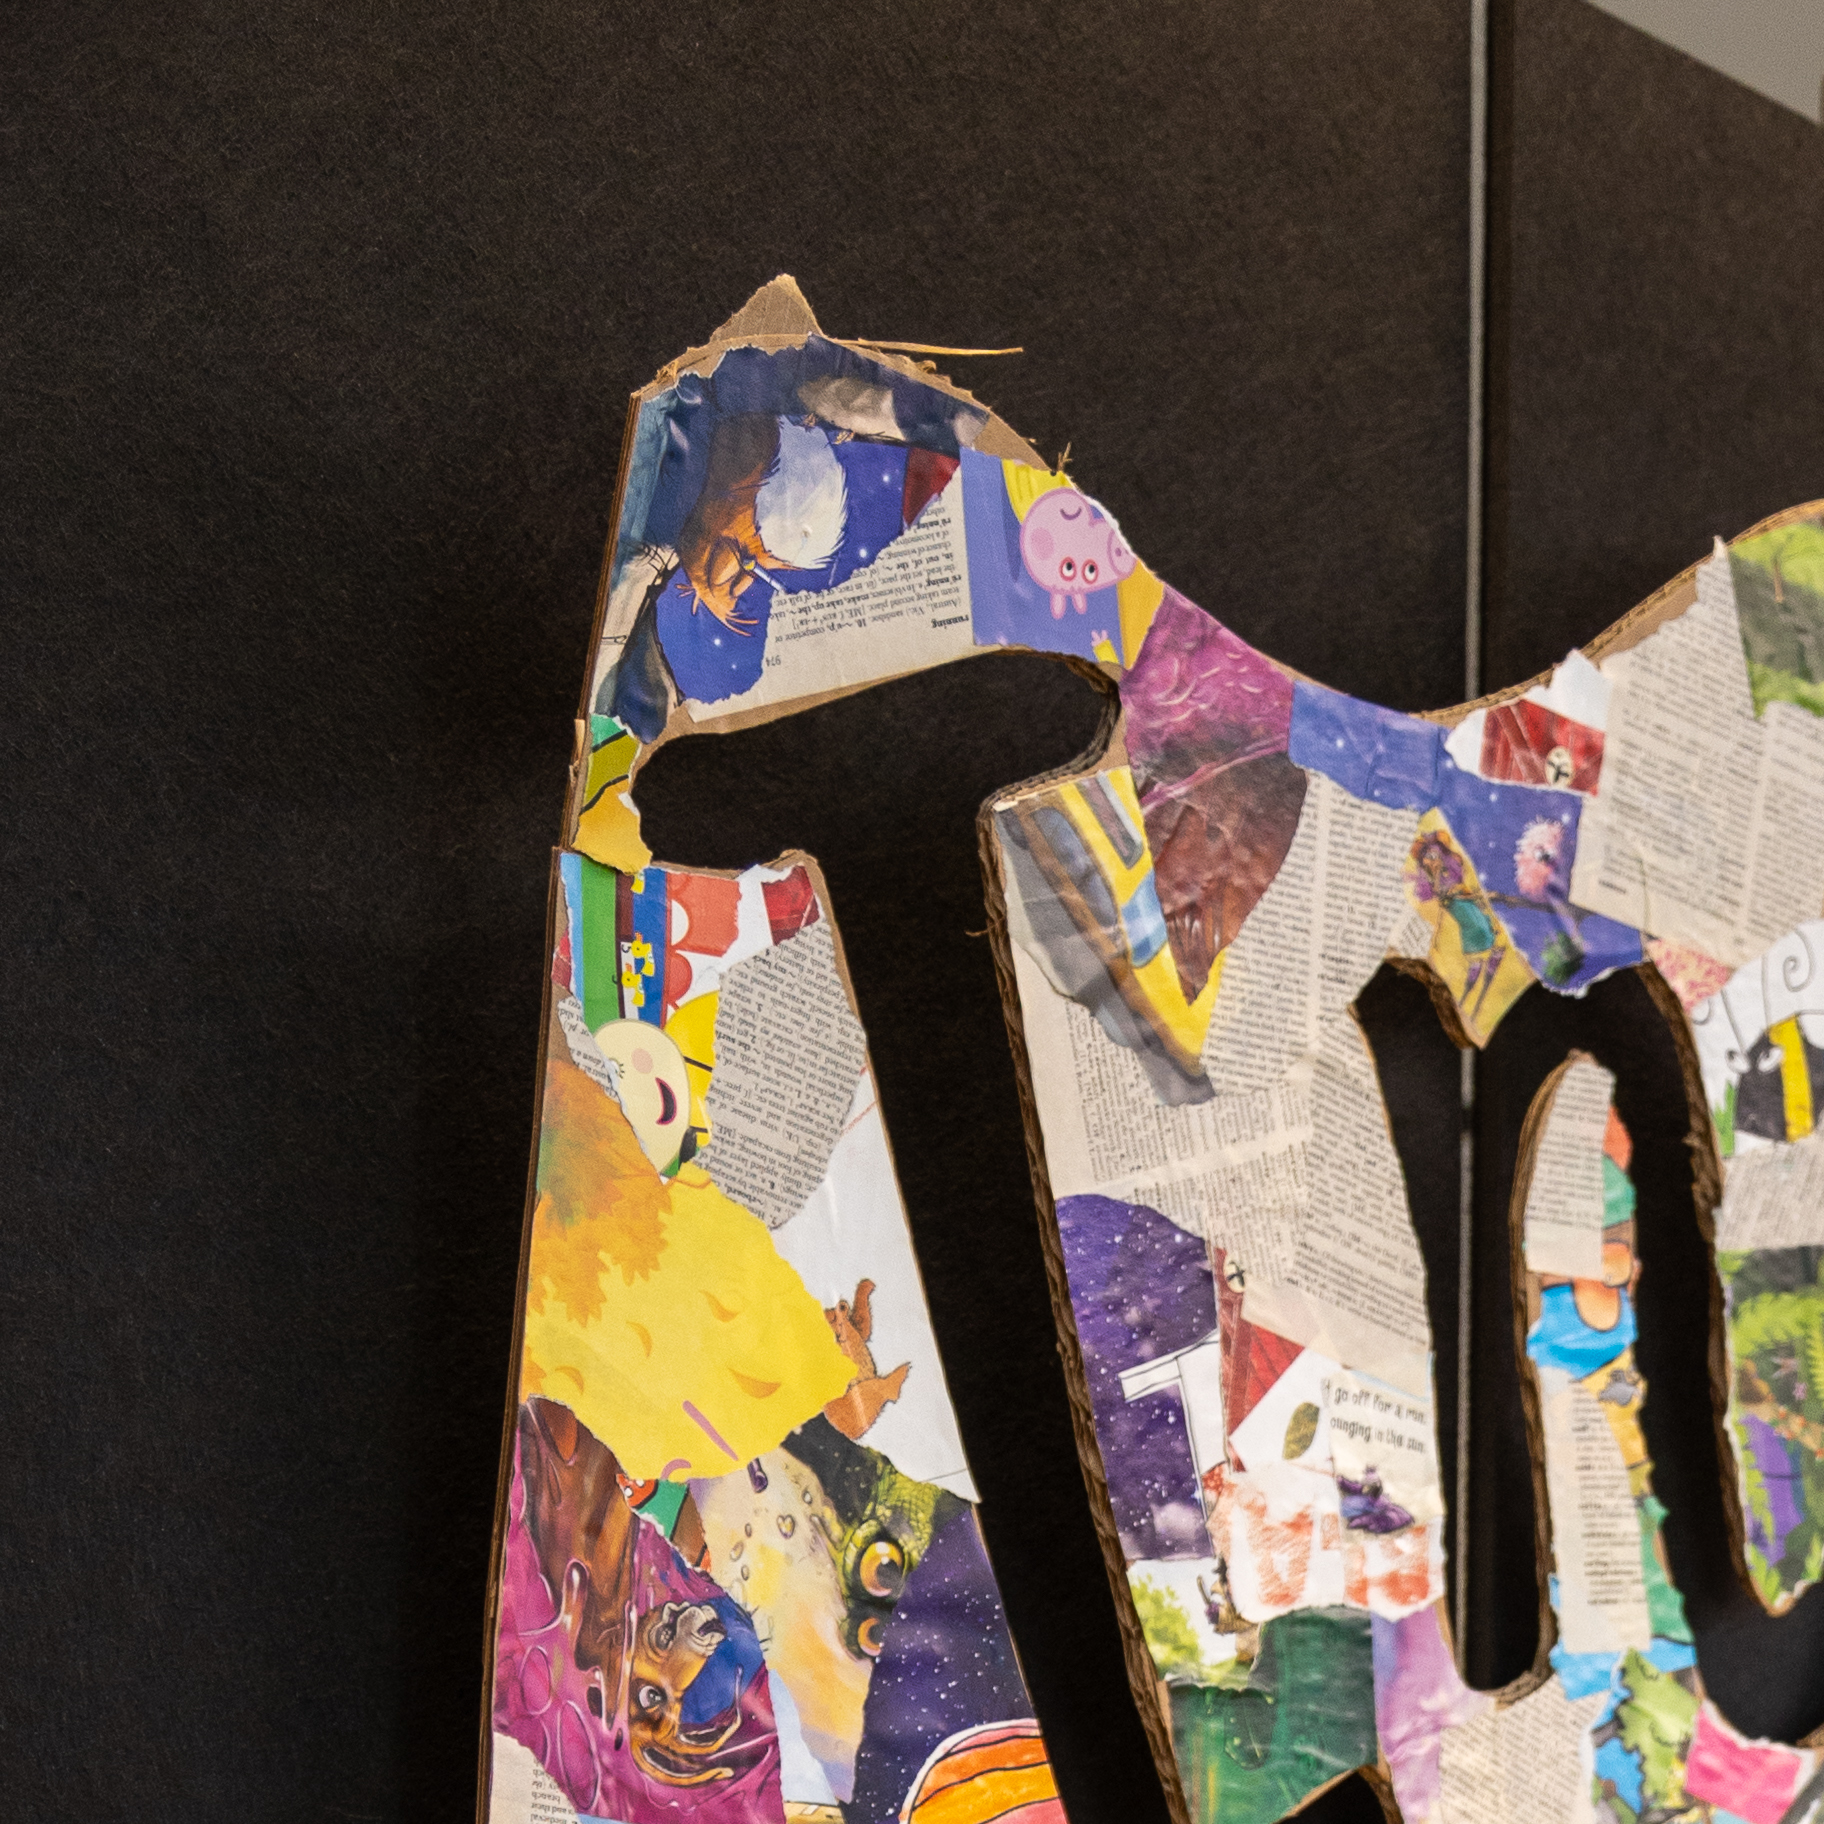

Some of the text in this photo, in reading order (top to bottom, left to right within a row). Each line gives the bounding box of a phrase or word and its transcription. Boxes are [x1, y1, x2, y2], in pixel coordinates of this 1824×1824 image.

[764, 612, 970, 668] running 974
[1372, 1391, 1393, 1413] for
